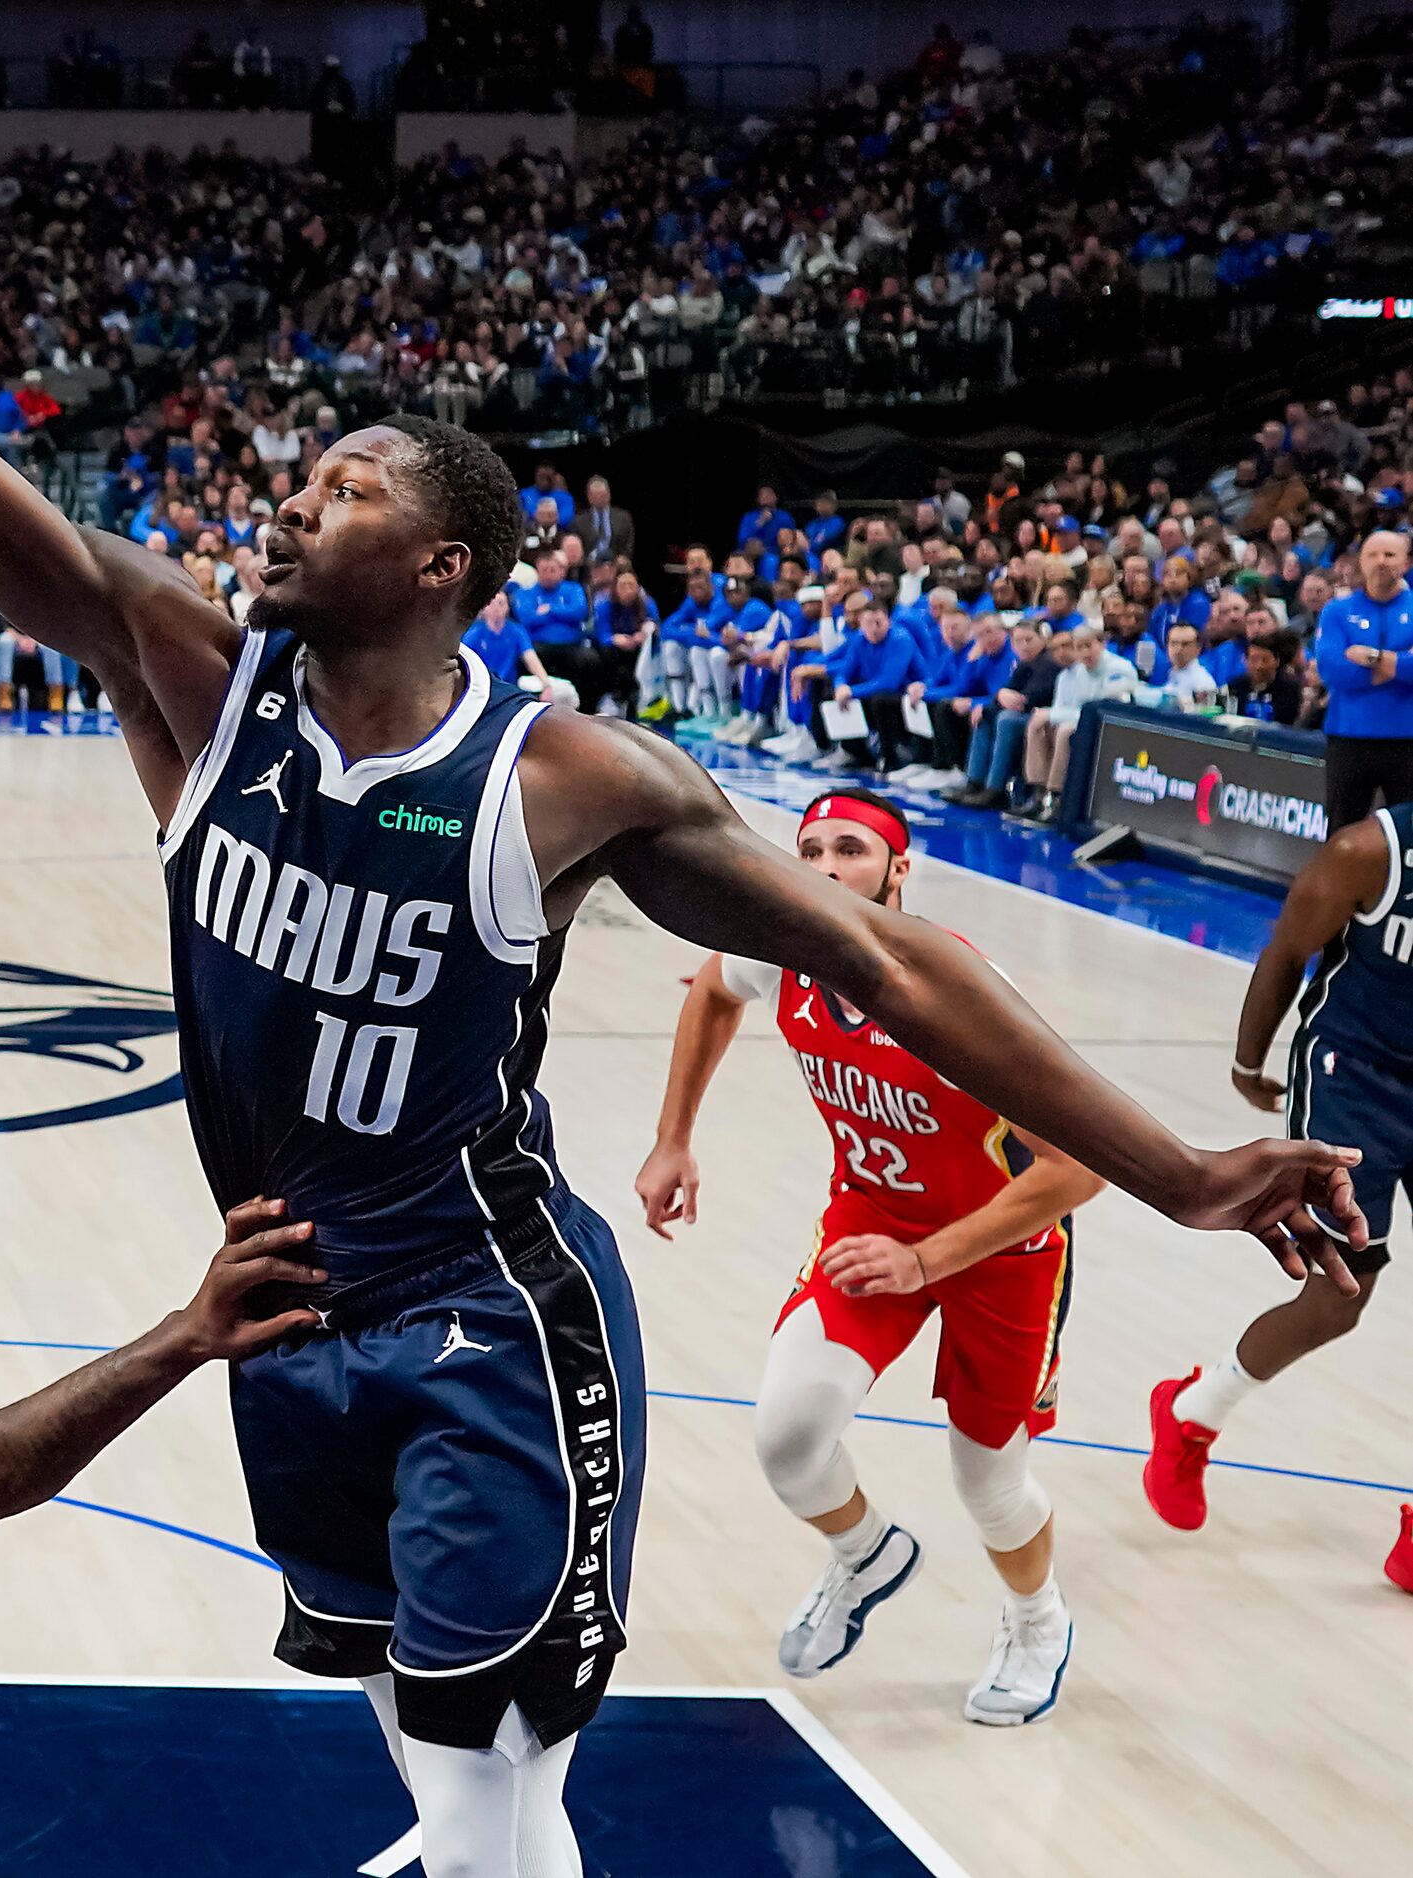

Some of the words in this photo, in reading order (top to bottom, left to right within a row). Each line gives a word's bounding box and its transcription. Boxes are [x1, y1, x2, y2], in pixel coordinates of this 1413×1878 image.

[256, 691, 286, 720] 6
[378, 804, 463, 838] chime
[1220, 783, 1329, 843] CRASHCHA
[303, 1011, 418, 1135] 10
[794, 1045, 940, 1136] ELICANS
[835, 1120, 927, 1193] 22
